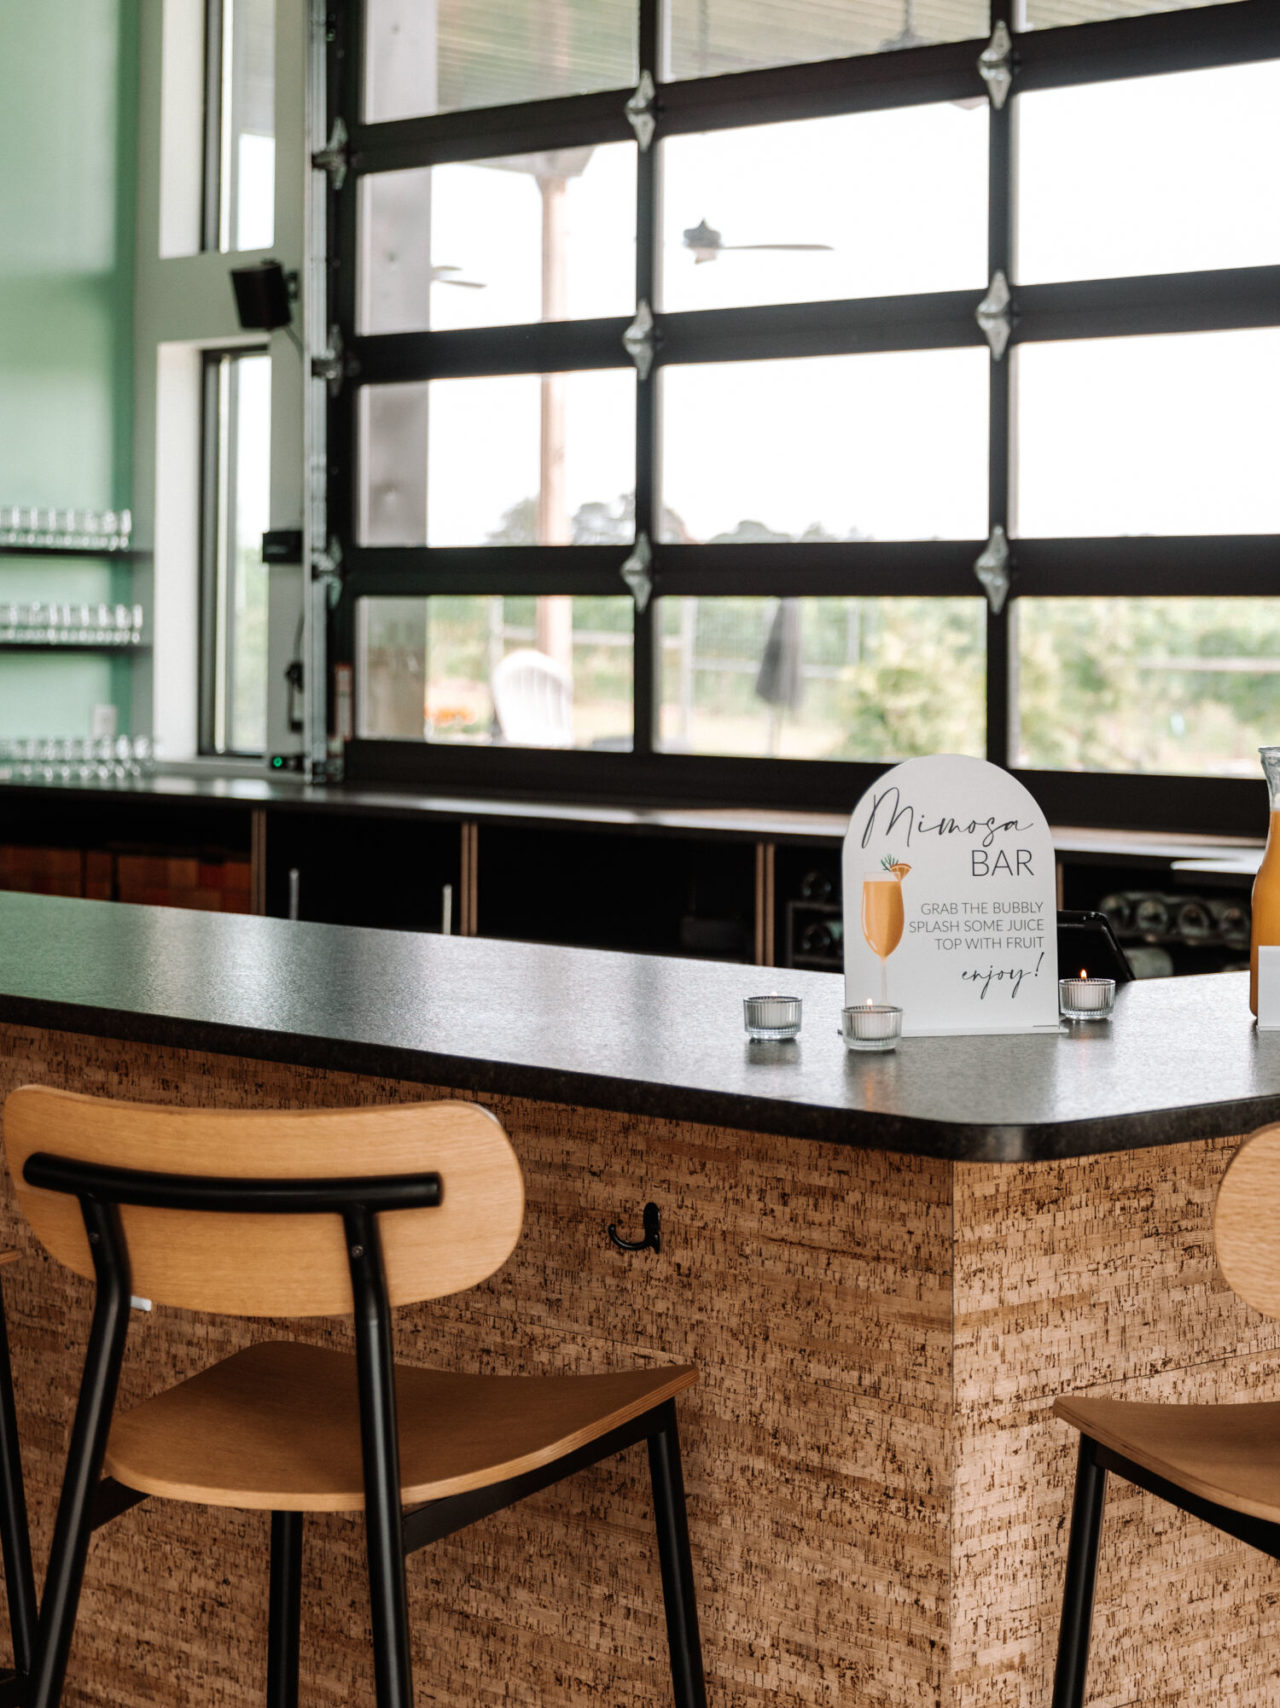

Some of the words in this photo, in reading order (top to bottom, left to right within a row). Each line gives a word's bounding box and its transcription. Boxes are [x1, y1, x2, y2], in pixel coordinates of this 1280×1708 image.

[860, 786, 1034, 849] Mimosa
[971, 849, 1035, 877] BAR
[920, 902, 959, 916] GRAB
[961, 902, 989, 915] THE
[992, 901, 1044, 914] BUBBLY
[908, 920, 960, 934] SPLASH
[963, 919, 1004, 933] SOME
[1006, 918, 1045, 932] JUICE
[934, 938, 963, 951] TOP
[965, 937, 1002, 950] WITH
[1006, 935, 1045, 949] FRUIT
[960, 951, 1046, 1001] enjoy!
